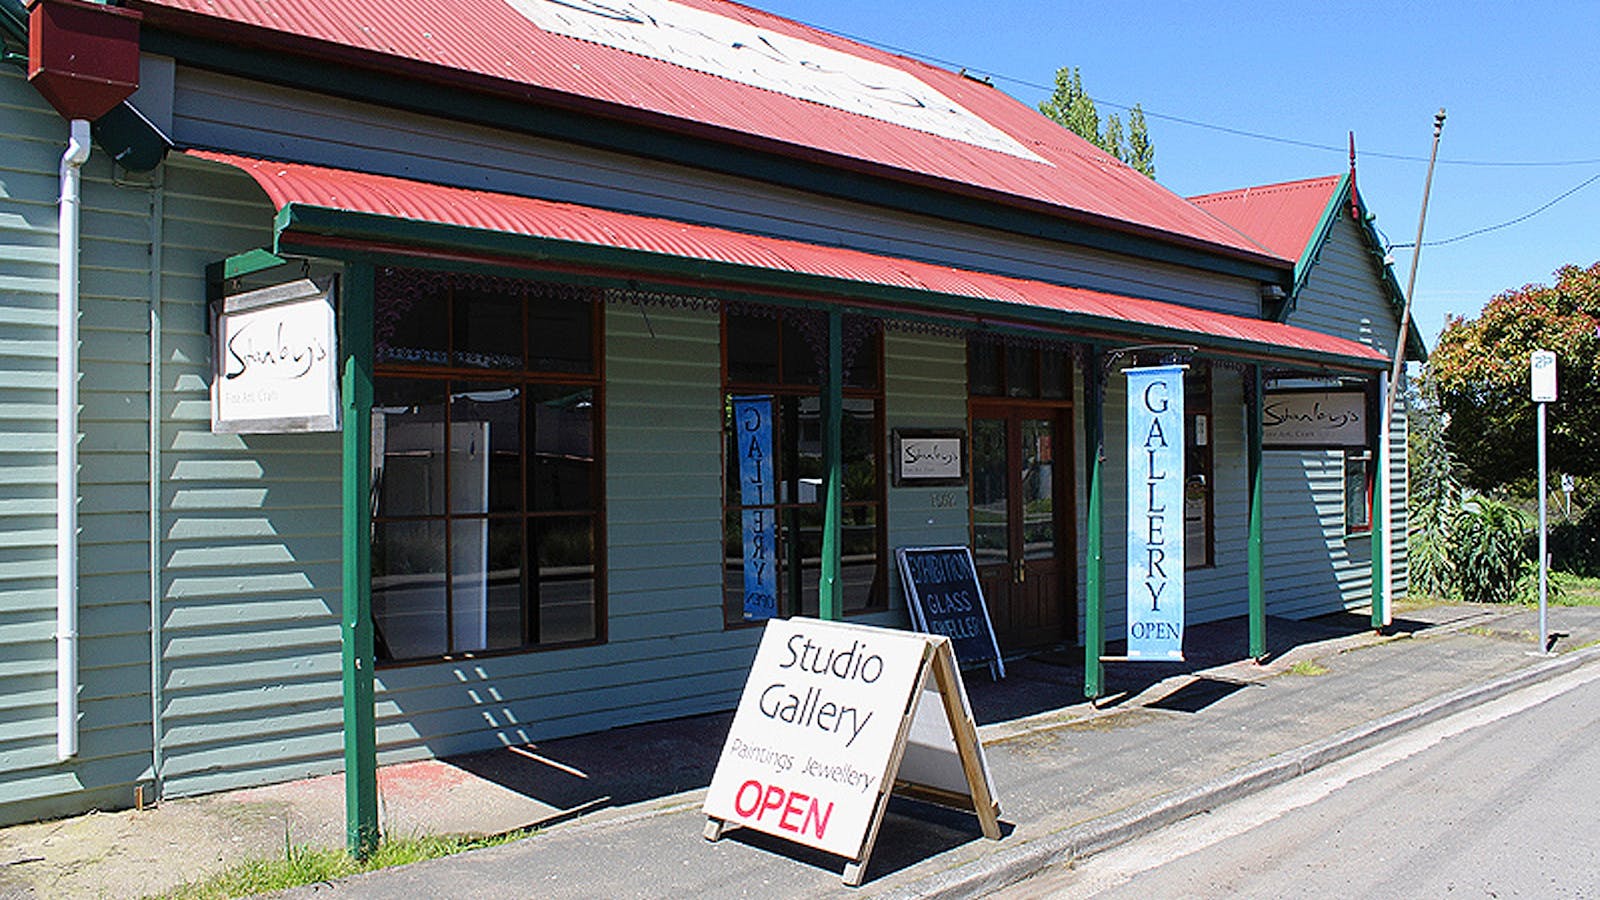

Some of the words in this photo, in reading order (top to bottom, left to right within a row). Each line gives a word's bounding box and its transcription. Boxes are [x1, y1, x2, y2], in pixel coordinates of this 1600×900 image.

[1144, 381, 1168, 611] GALLERY
[927, 590, 973, 615] GLASS
[780, 634, 884, 683] Studio
[1131, 622, 1180, 640] OPEN
[760, 684, 873, 748] Gallery
[731, 738, 795, 774] Paintings
[801, 757, 876, 794] Jewellery
[734, 780, 834, 840] OPEN
